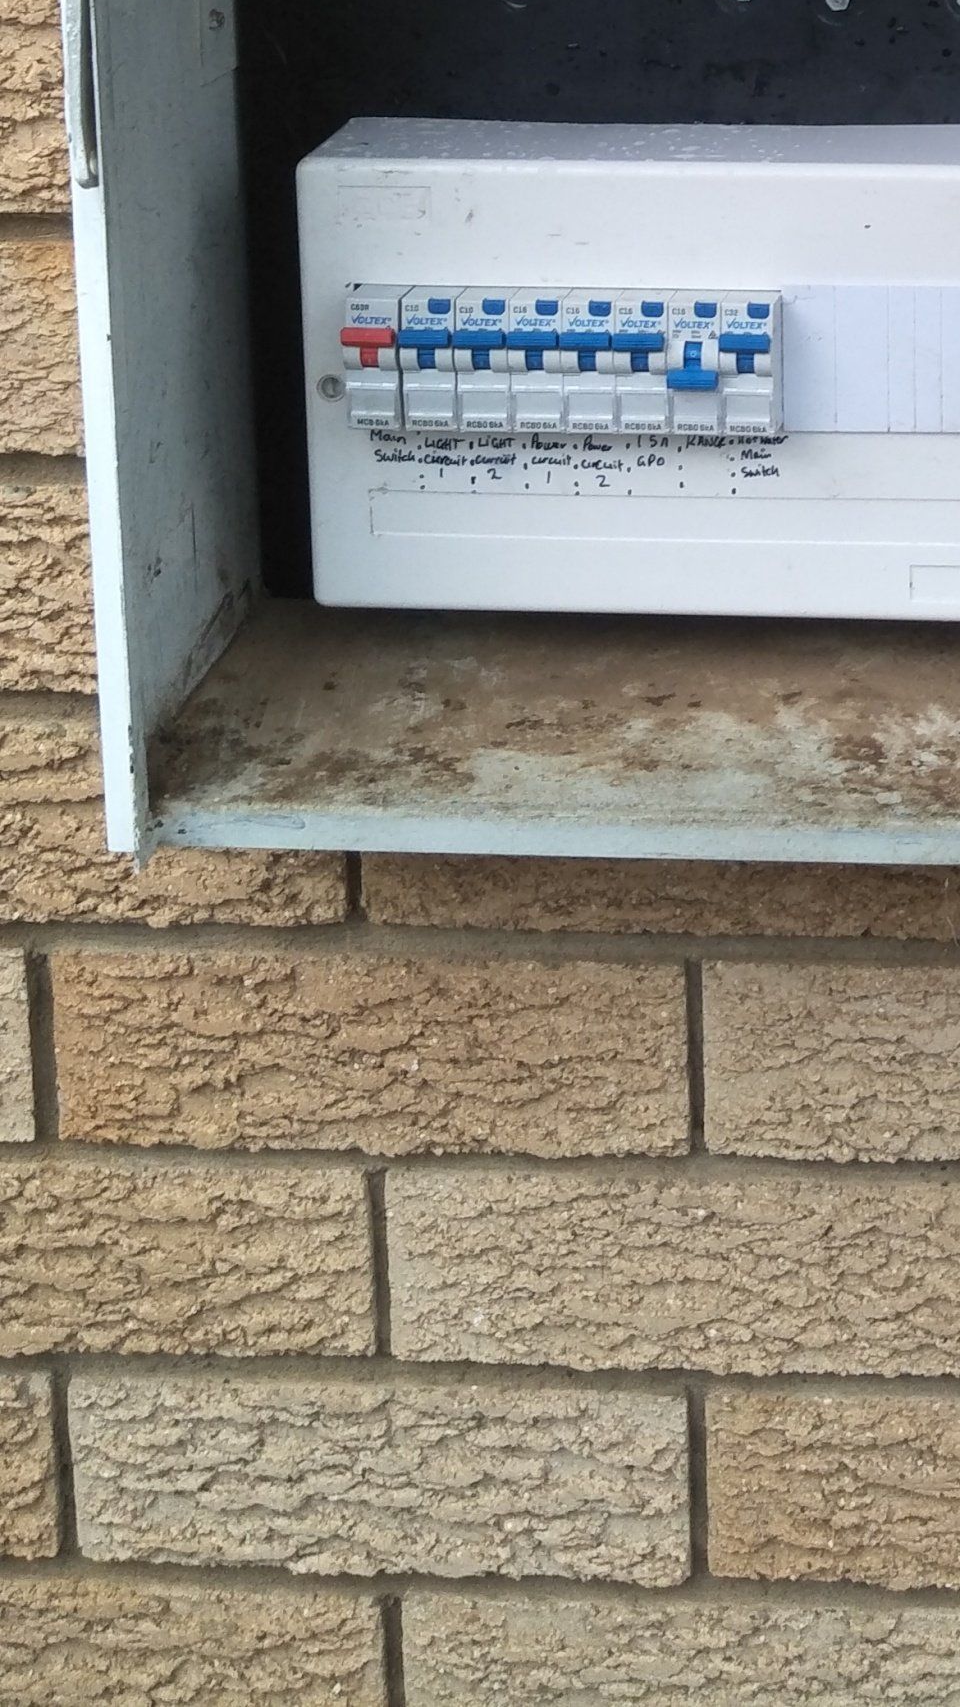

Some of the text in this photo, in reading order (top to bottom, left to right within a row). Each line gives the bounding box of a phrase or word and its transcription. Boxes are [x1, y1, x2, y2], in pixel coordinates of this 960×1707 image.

[370, 430, 407, 445] Main
[486, 467, 503, 480] 2
[595, 475, 611, 487] 2
